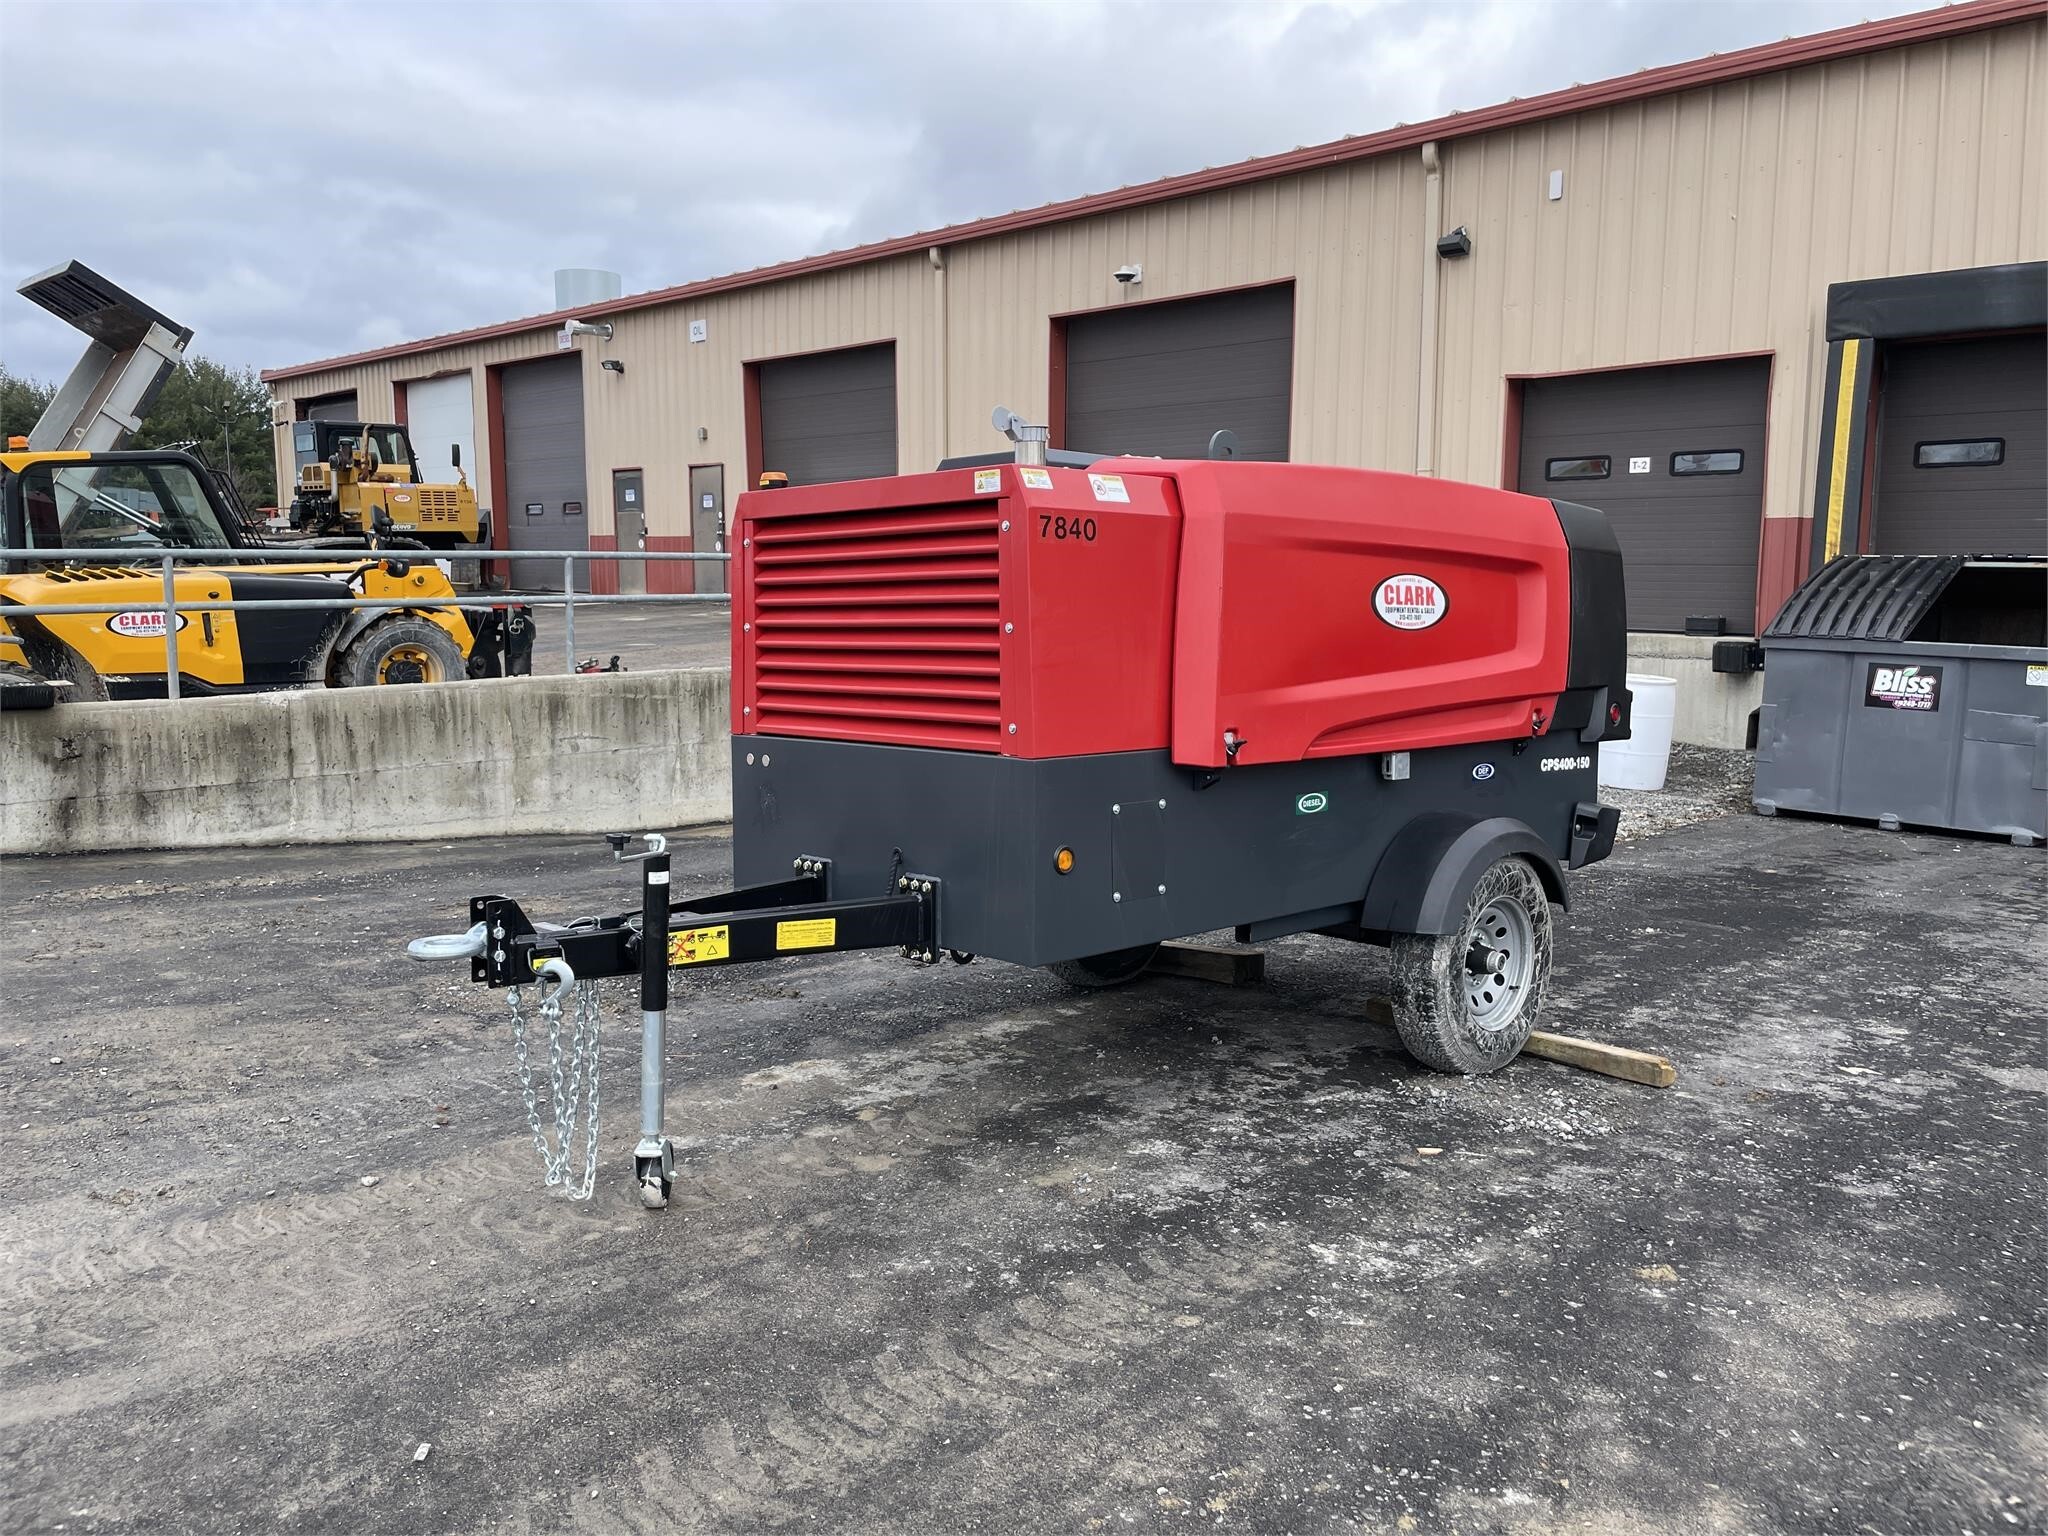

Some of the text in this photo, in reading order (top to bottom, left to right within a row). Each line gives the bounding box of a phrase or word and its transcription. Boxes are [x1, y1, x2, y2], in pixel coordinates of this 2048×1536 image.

[1632, 460, 1648, 470] T-2
[1039, 514, 1097, 542] 7840
[1383, 584, 1436, 606] CLARK
[1385, 606, 1406, 614] EQUIPMENT
[1873, 666, 1936, 694] Bliss
[1478, 766, 1490, 775] DEF
[1540, 756, 1590, 772] CPS400-150
[1302, 798, 1322, 808] DIESEL
